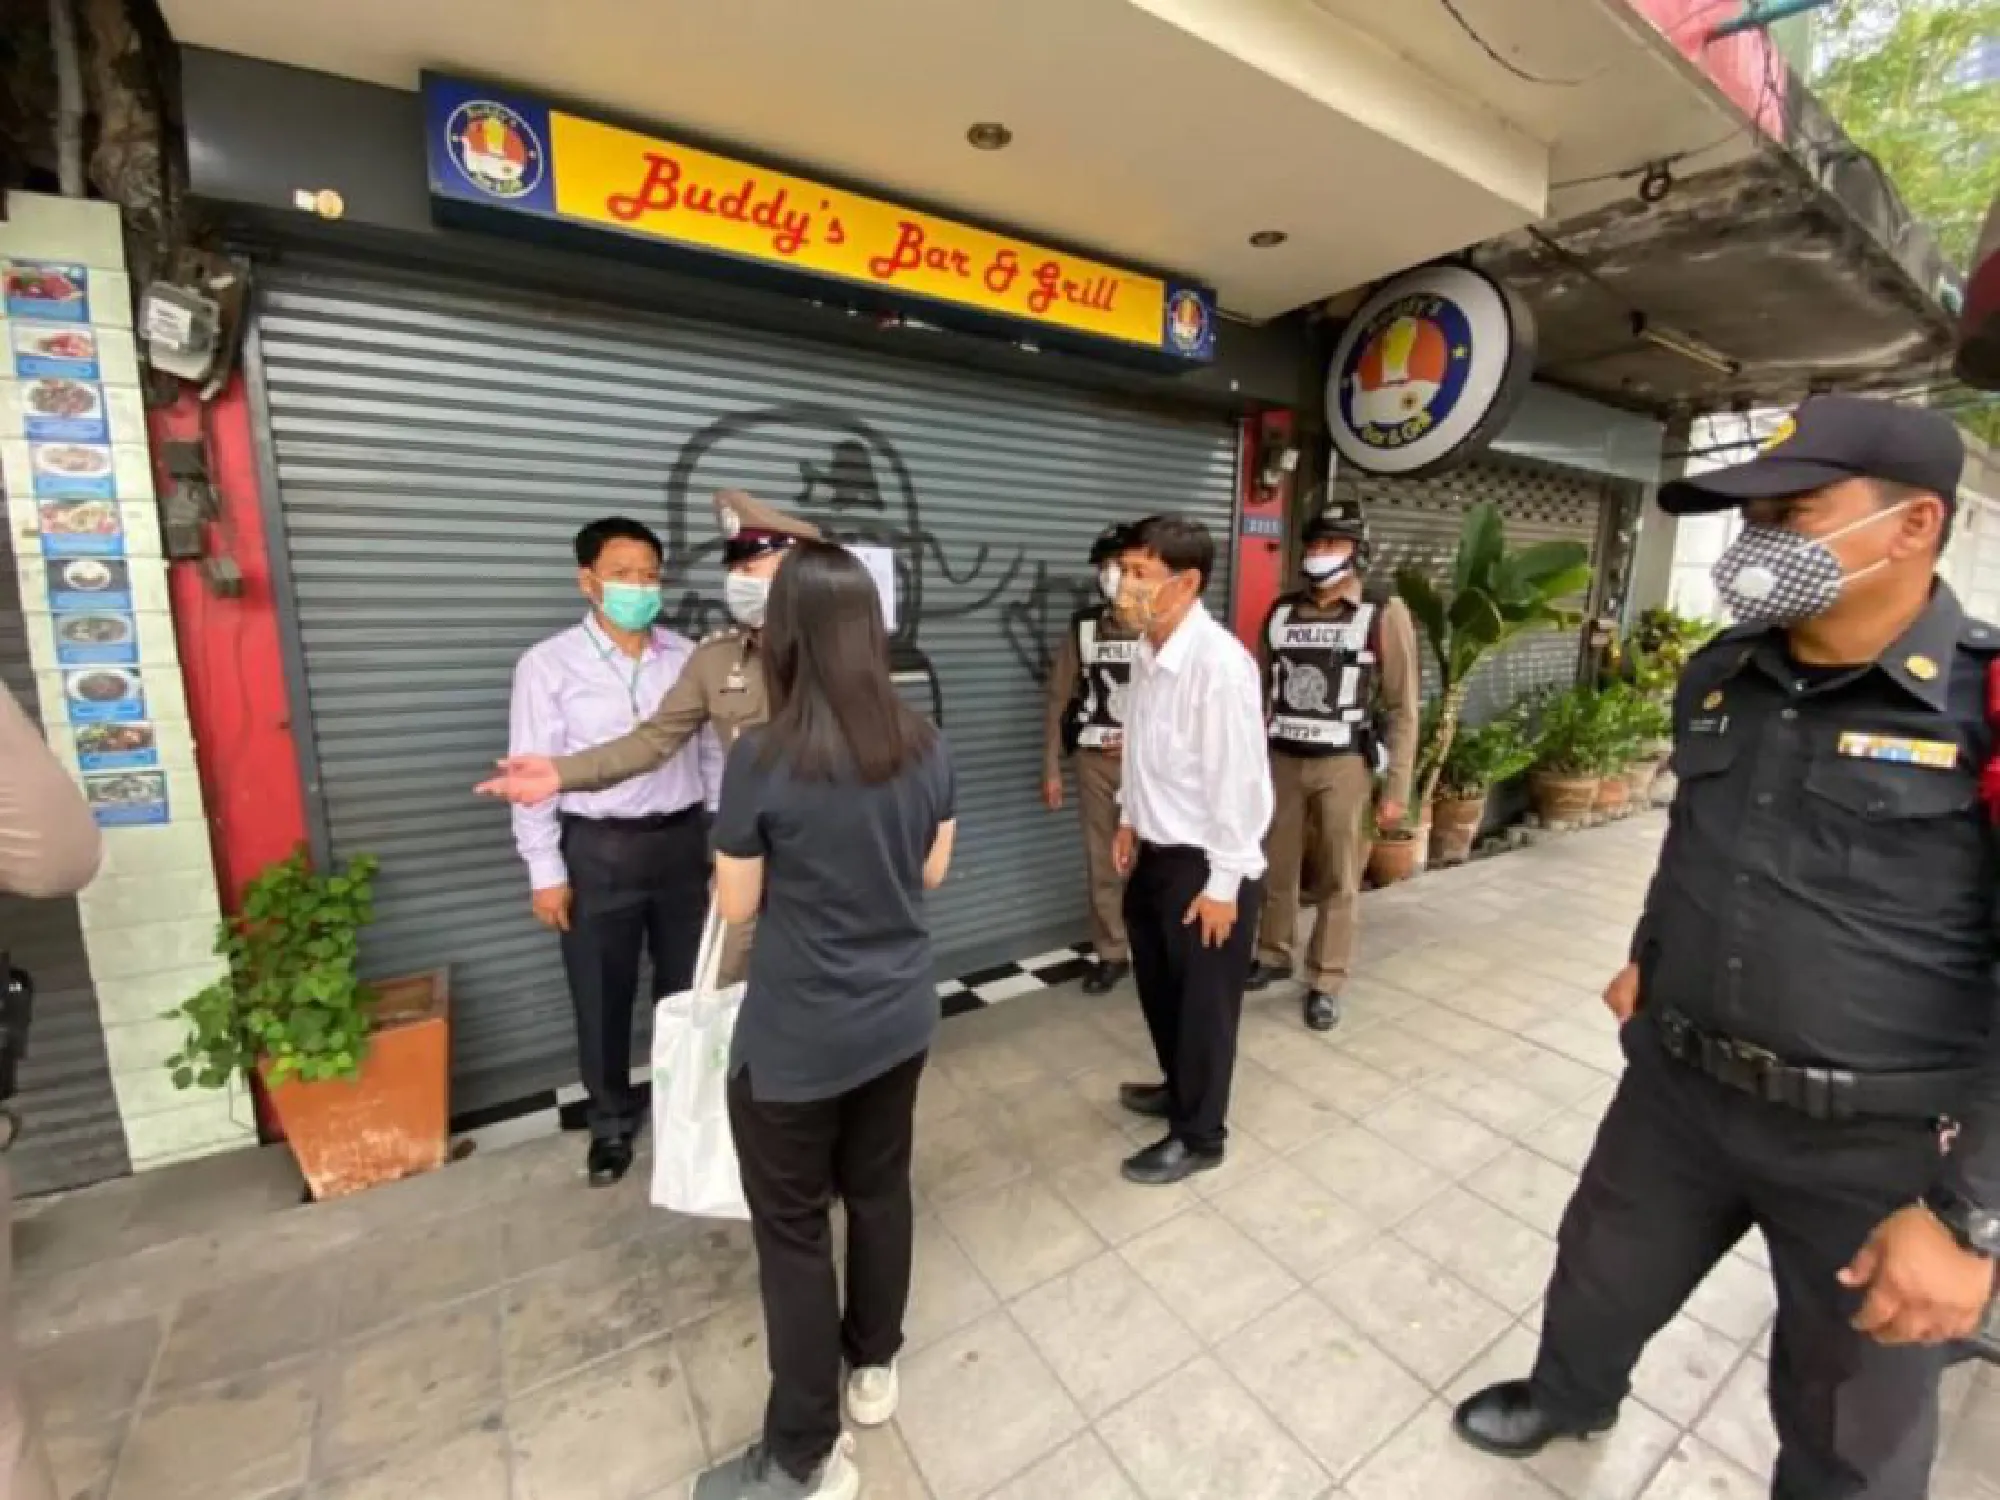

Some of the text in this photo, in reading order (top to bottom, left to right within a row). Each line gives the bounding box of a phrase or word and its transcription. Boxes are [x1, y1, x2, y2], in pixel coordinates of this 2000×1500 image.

[607, 152, 1120, 313] Buddy's Bar & Grill
[1284, 627, 1347, 643] POLICE
